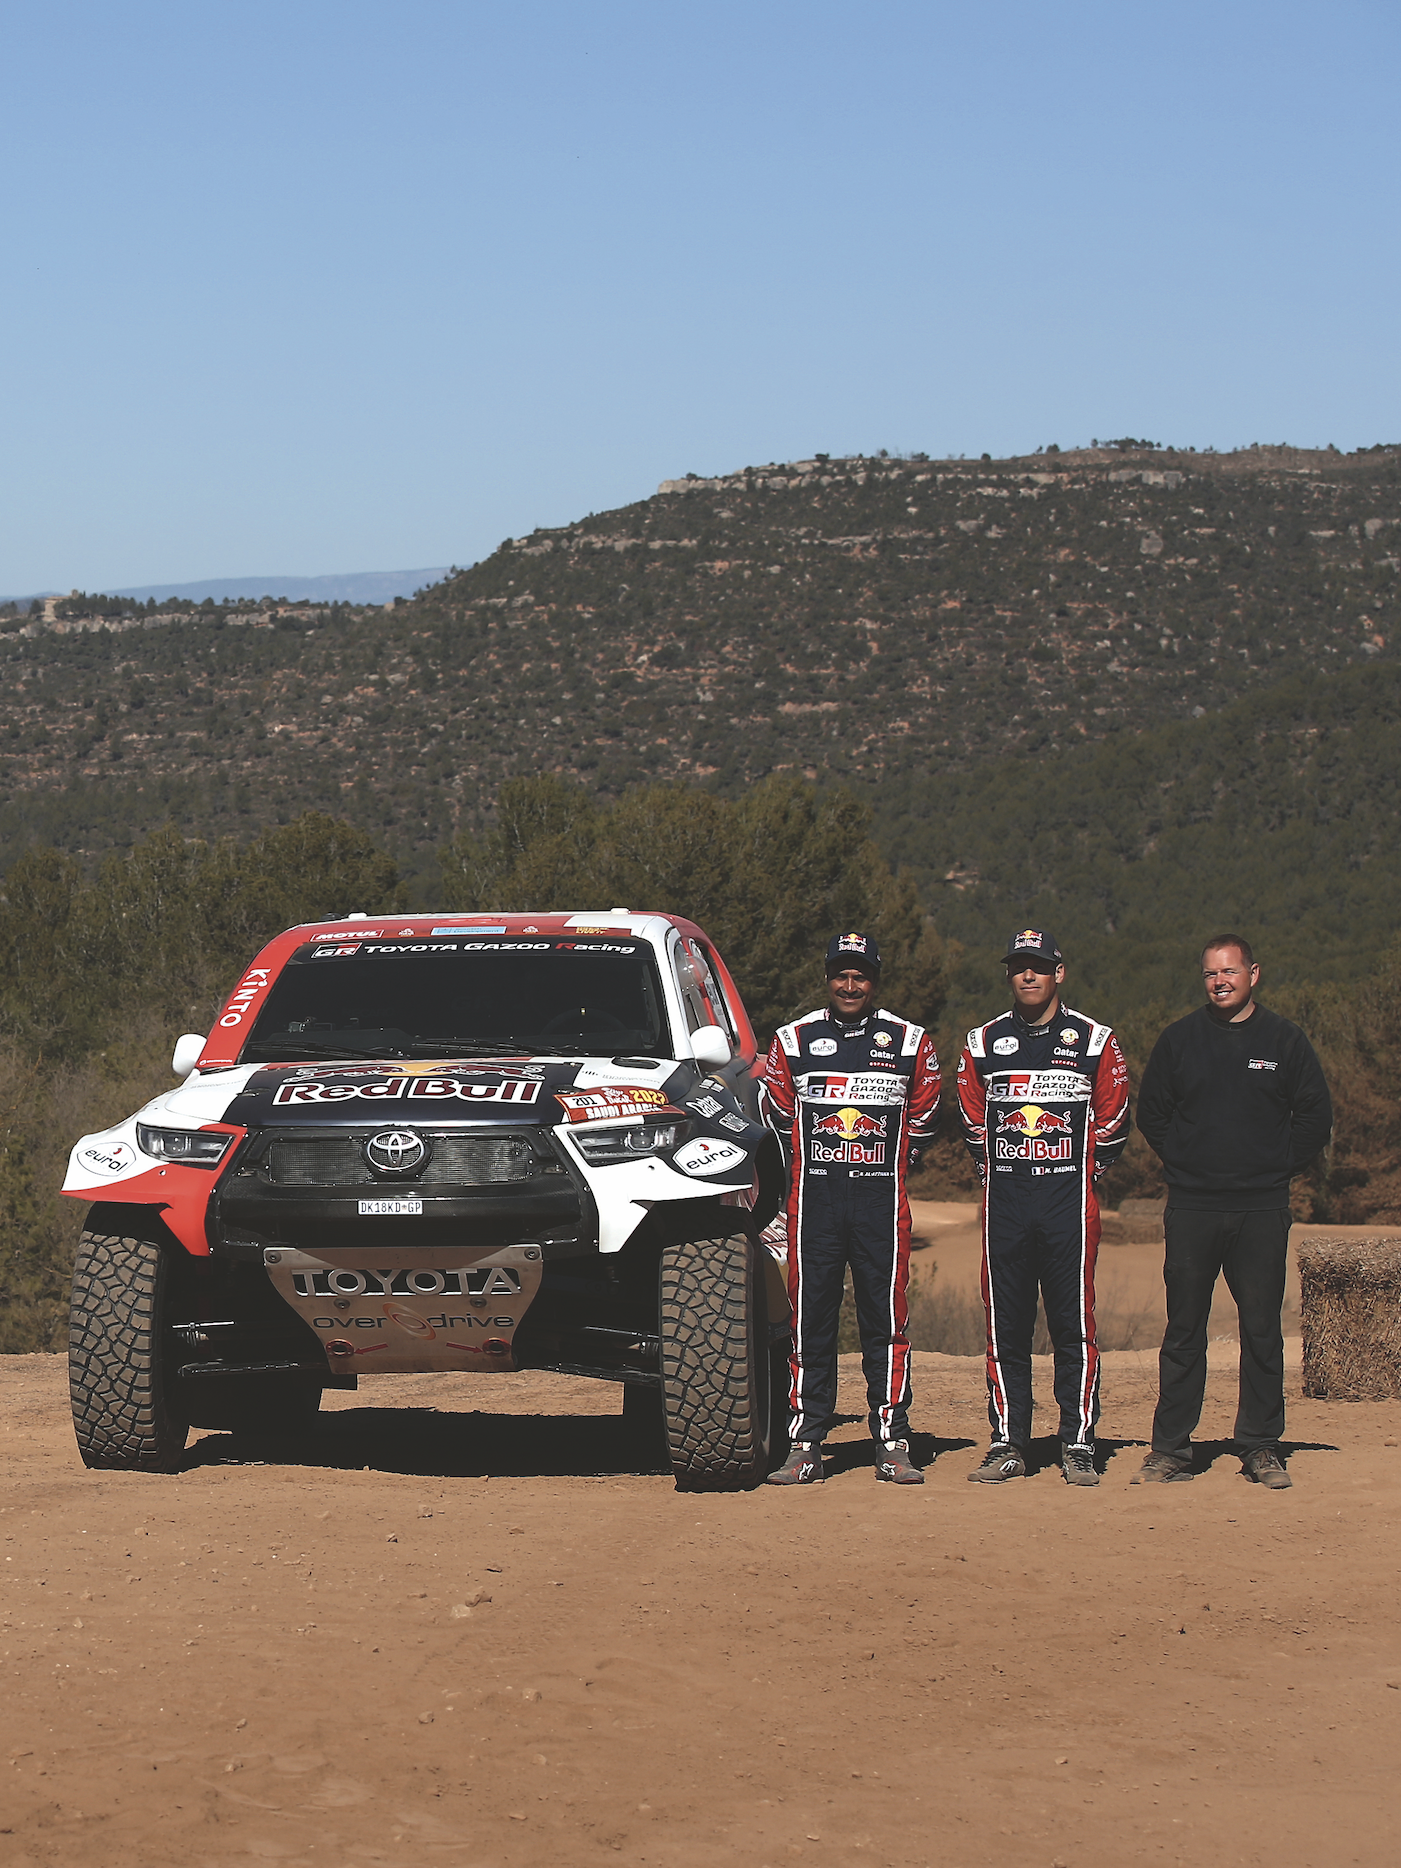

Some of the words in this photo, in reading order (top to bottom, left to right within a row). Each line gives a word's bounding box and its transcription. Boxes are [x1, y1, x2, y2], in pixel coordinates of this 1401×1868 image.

[316, 930, 378, 940] MOTUL
[313, 945, 357, 958] GR
[364, 944, 458, 954] TOYOTA
[463, 942, 550, 951] GAZOO
[555, 942, 636, 954] Racing
[812, 1044, 836, 1052] eurol
[994, 1042, 1018, 1051] eurol
[1053, 1047, 1080, 1058] Qatar
[870, 1049, 896, 1060] Qatar
[852, 1077, 898, 1086] TOYOTA
[1035, 1074, 1079, 1083] TOYOTA
[275, 1077, 403, 1104] Red
[410, 1079, 541, 1104] Bull
[808, 1084, 846, 1098] GR
[850, 1085, 893, 1093] GAZOO
[992, 1083, 1029, 1097] GR
[1032, 1082, 1076, 1090] GAZOO
[849, 1093, 890, 1101] Racing
[1030, 1089, 1074, 1098] Racing
[574, 1095, 598, 1107] 201
[685, 1095, 724, 1118] Qatar
[585, 1105, 621, 1119] SAUDI
[811, 1141, 847, 1162] Red
[849, 1143, 886, 1163] Bull
[996, 1138, 1031, 1159] Red
[1033, 1138, 1072, 1160] Bull
[85, 1149, 128, 1172] eurol
[686, 1146, 738, 1170] eurol
[360, 1202, 401, 1214] DK18KD
[407, 1202, 422, 1214] GP
[291, 1267, 521, 1296] TOYOTA
